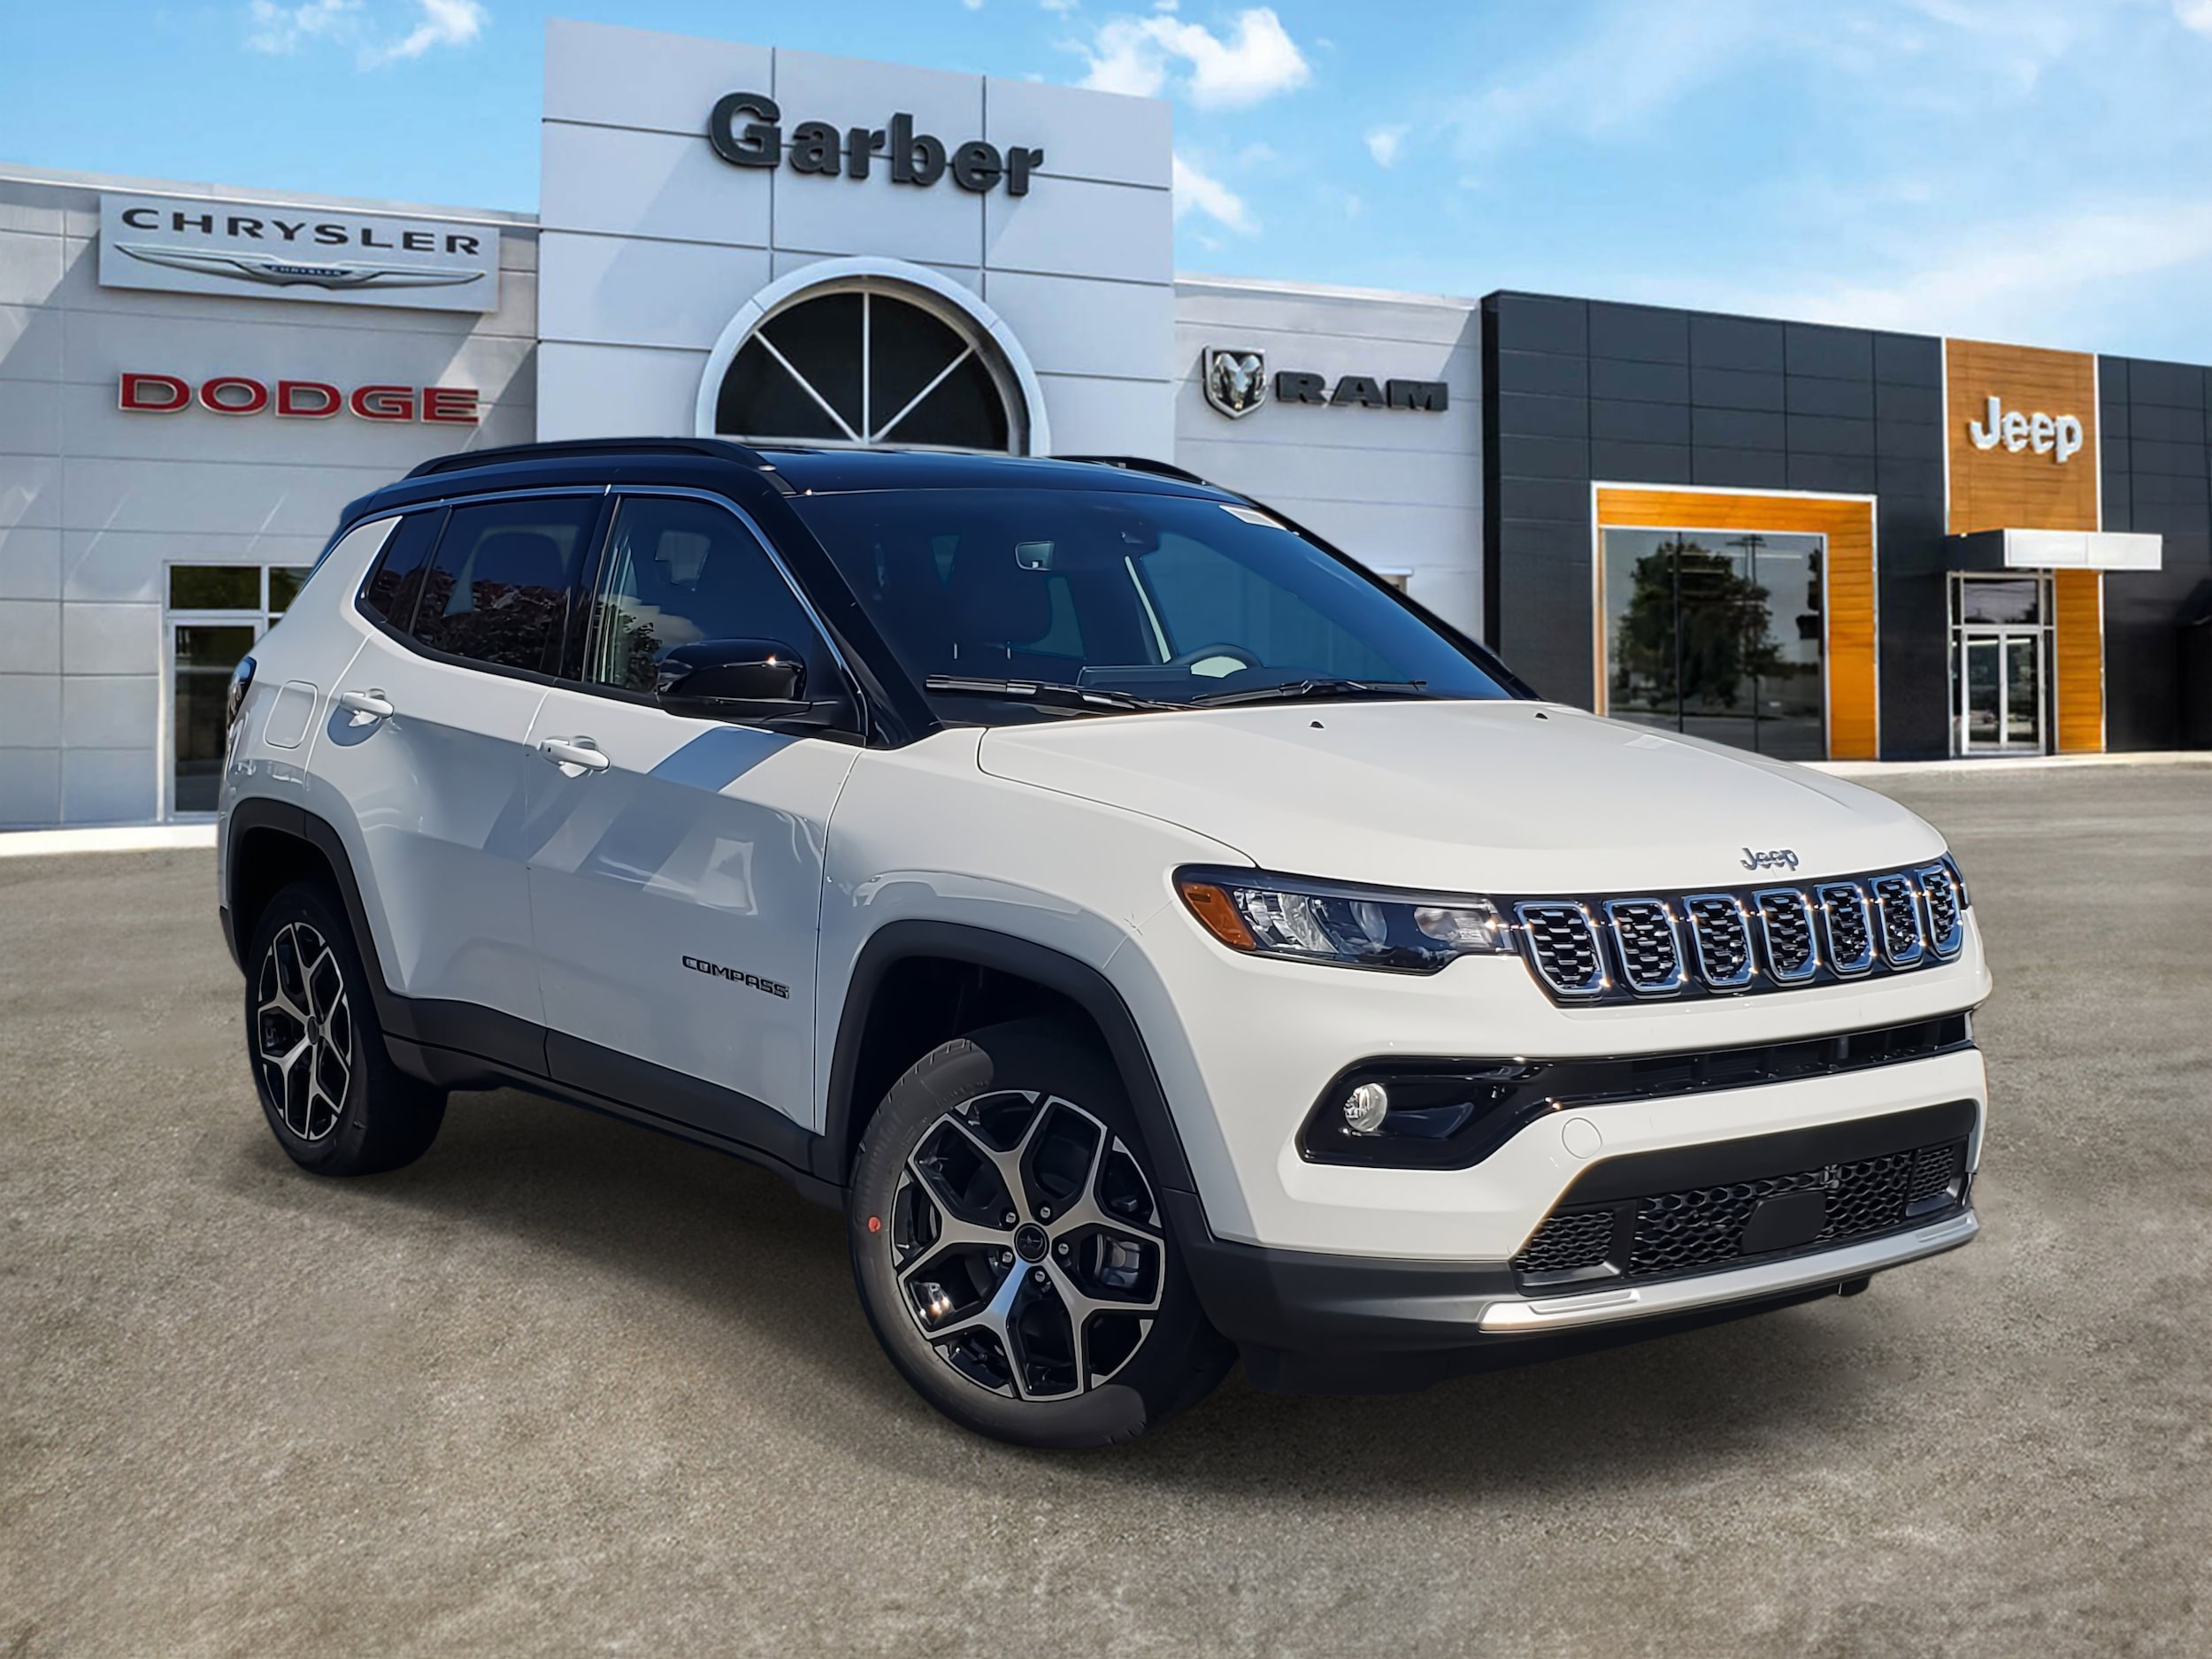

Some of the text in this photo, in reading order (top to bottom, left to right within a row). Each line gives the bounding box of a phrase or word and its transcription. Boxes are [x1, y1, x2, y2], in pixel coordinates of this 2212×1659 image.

[709, 92, 1044, 196] Garber
[122, 208, 480, 256] CHRYSLER
[119, 372, 480, 425] DODGE
[1275, 371, 1448, 411] RAM
[1967, 396, 2084, 464] Jeep
[1740, 847, 1800, 872] Jeep
[681, 955, 790, 1000] COMPASS
